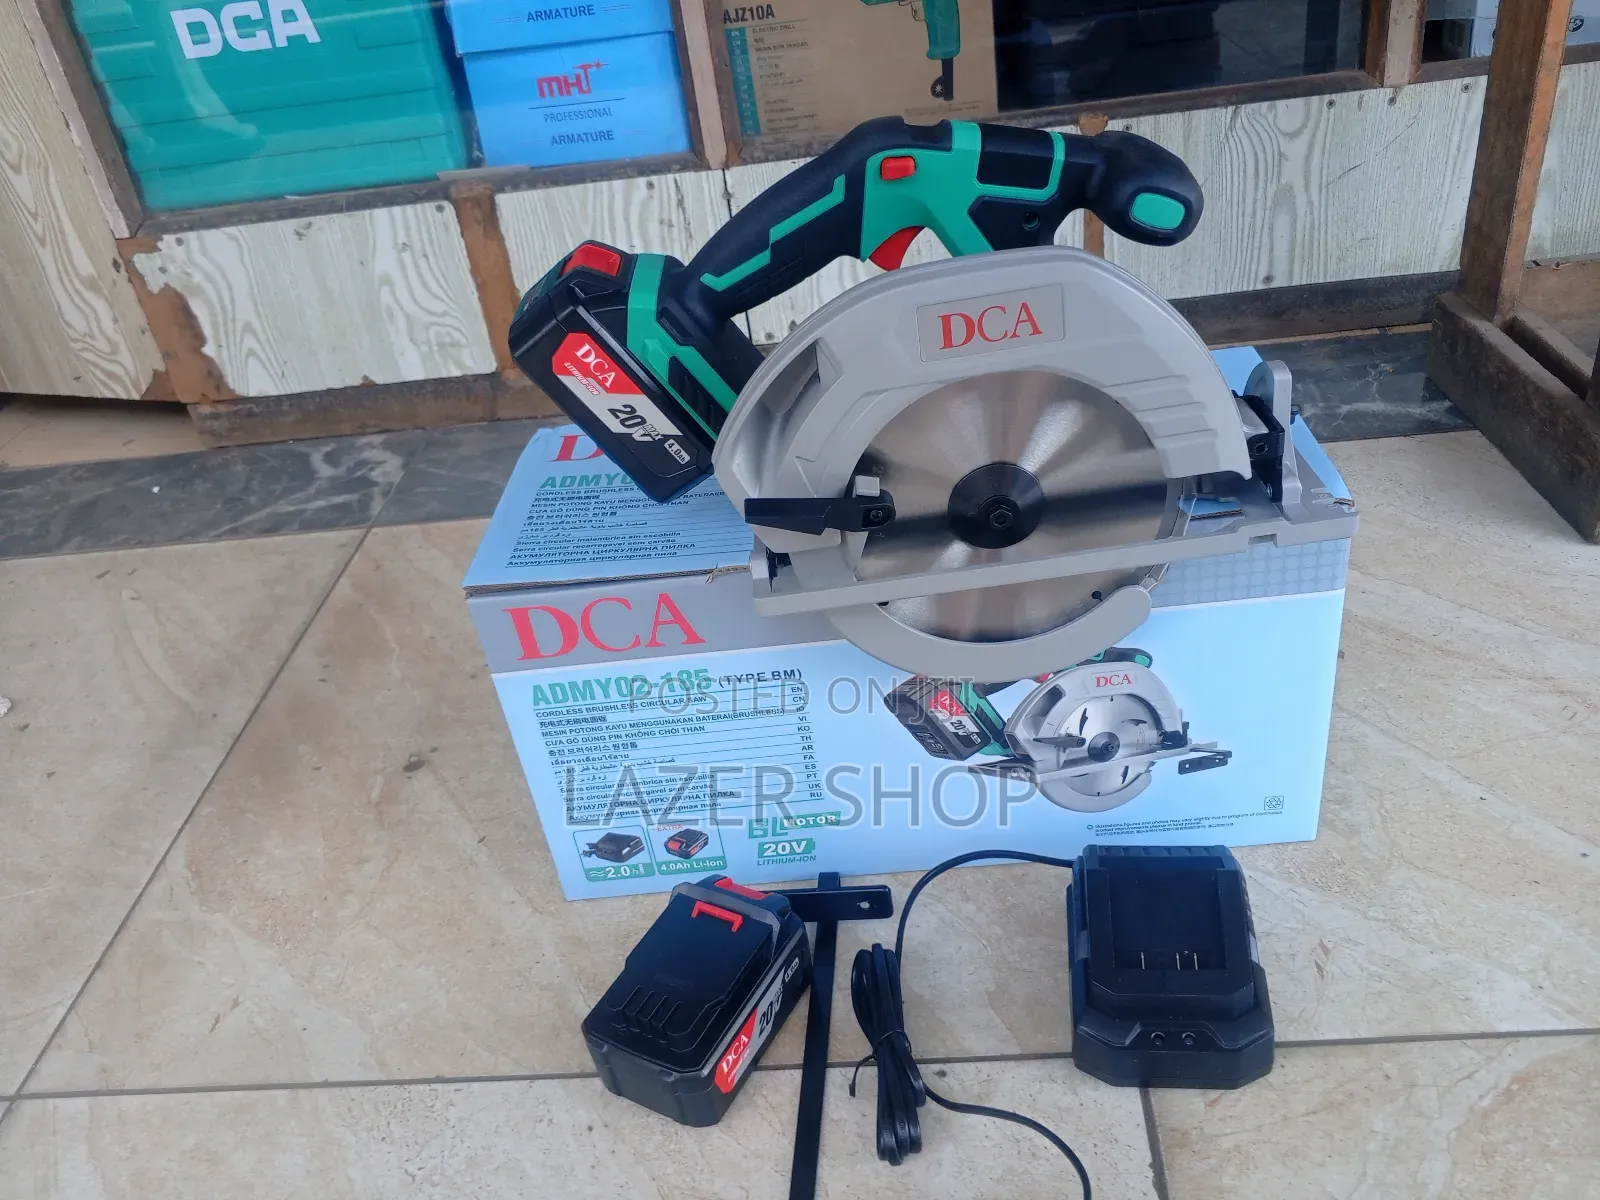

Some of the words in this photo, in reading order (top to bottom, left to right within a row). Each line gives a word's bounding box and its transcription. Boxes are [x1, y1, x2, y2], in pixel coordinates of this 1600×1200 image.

[526, 4, 596, 23] ARMATURE
[723, 3, 776, 25] AJZ10A
[171, 0, 321, 60] DCA
[543, 107, 614, 123] PROFESSIONAL
[551, 130, 615, 147] ARMATURE
[937, 301, 1043, 351] DCA
[574, 343, 616, 389] DCA
[563, 362, 601, 396] LITHIUM-ION
[501, 592, 707, 661] DCA
[532, 668, 712, 707] ADMY02-185
[718, 672, 768, 688] (TYPE
[771, 668, 802, 681] BM)
[1095, 673, 1132, 688] DCA
[536, 707, 584, 718] CORDLESS
[586, 701, 639, 713] BRUSHLESS
[640, 697, 685, 708] CIRCULAR
[687, 695, 707, 704] SAW
[541, 729, 567, 737] MESIN
[569, 725, 603, 734] POTONG
[605, 721, 627, 731] KAYU
[629, 716, 694, 728] MENGGUNAKAN
[608, 733, 623, 741] PIN
[681, 725, 705, 734] THAN
[586, 783, 615, 792] circular
[586, 793, 615, 801] circular
[809, 791, 823, 799] RU
[566, 800, 639, 812] АКУМУЛЯТОРНА
[703, 791, 736, 800] ПИЛКА
[783, 815, 837, 828] MOTOR
[763, 840, 808, 857] 20V
[660, 862, 691, 871] 4.0Ah
[693, 860, 724, 868] Li-Ion
[757, 855, 817, 866] LITHIUM-ION
[720, 1034, 749, 1075] DCA
